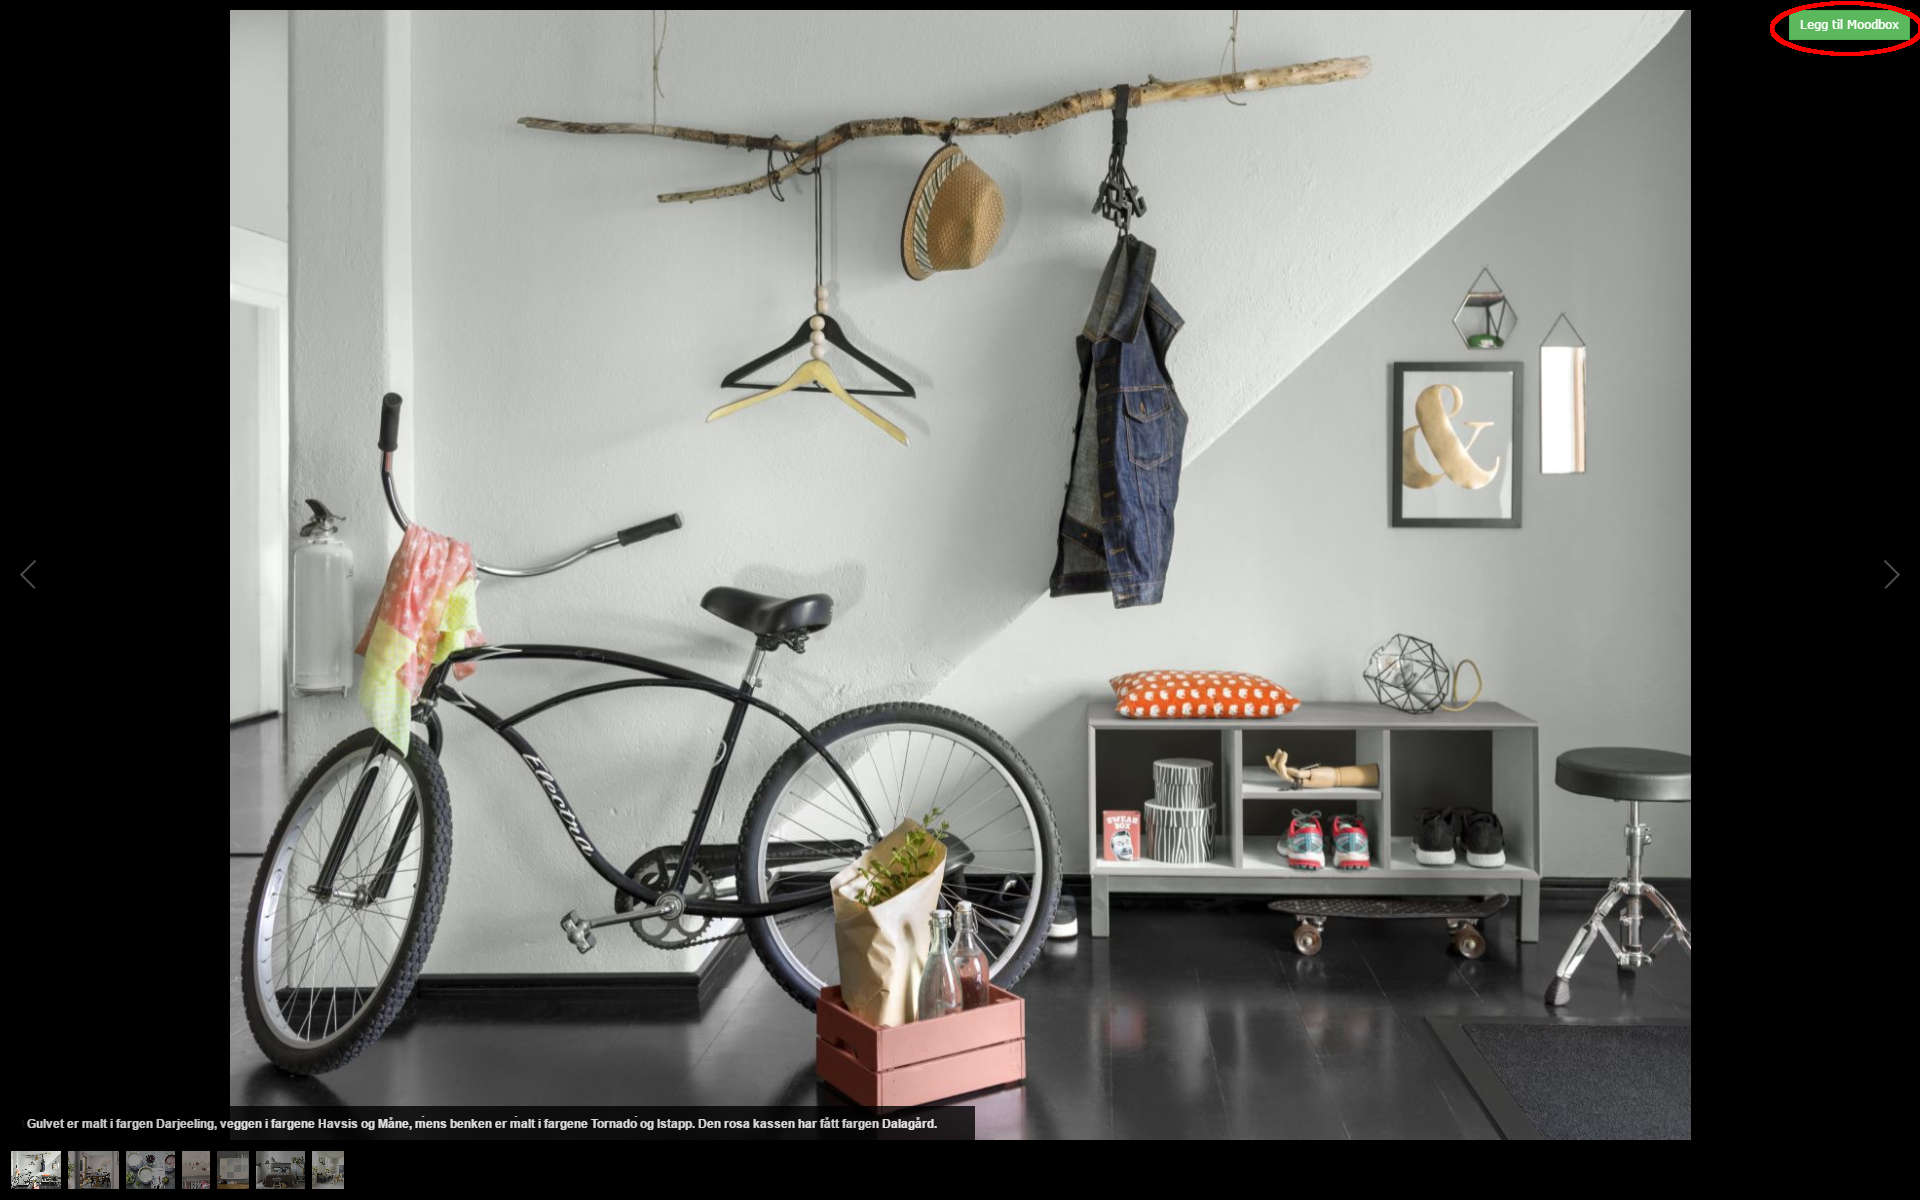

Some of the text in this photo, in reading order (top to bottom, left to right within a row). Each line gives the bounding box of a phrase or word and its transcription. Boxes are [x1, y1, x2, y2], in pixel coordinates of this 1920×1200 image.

[1403, 383, 1500, 490] &
[522, 753, 595, 857] Electra
[1114, 822, 1131, 830] BOX
